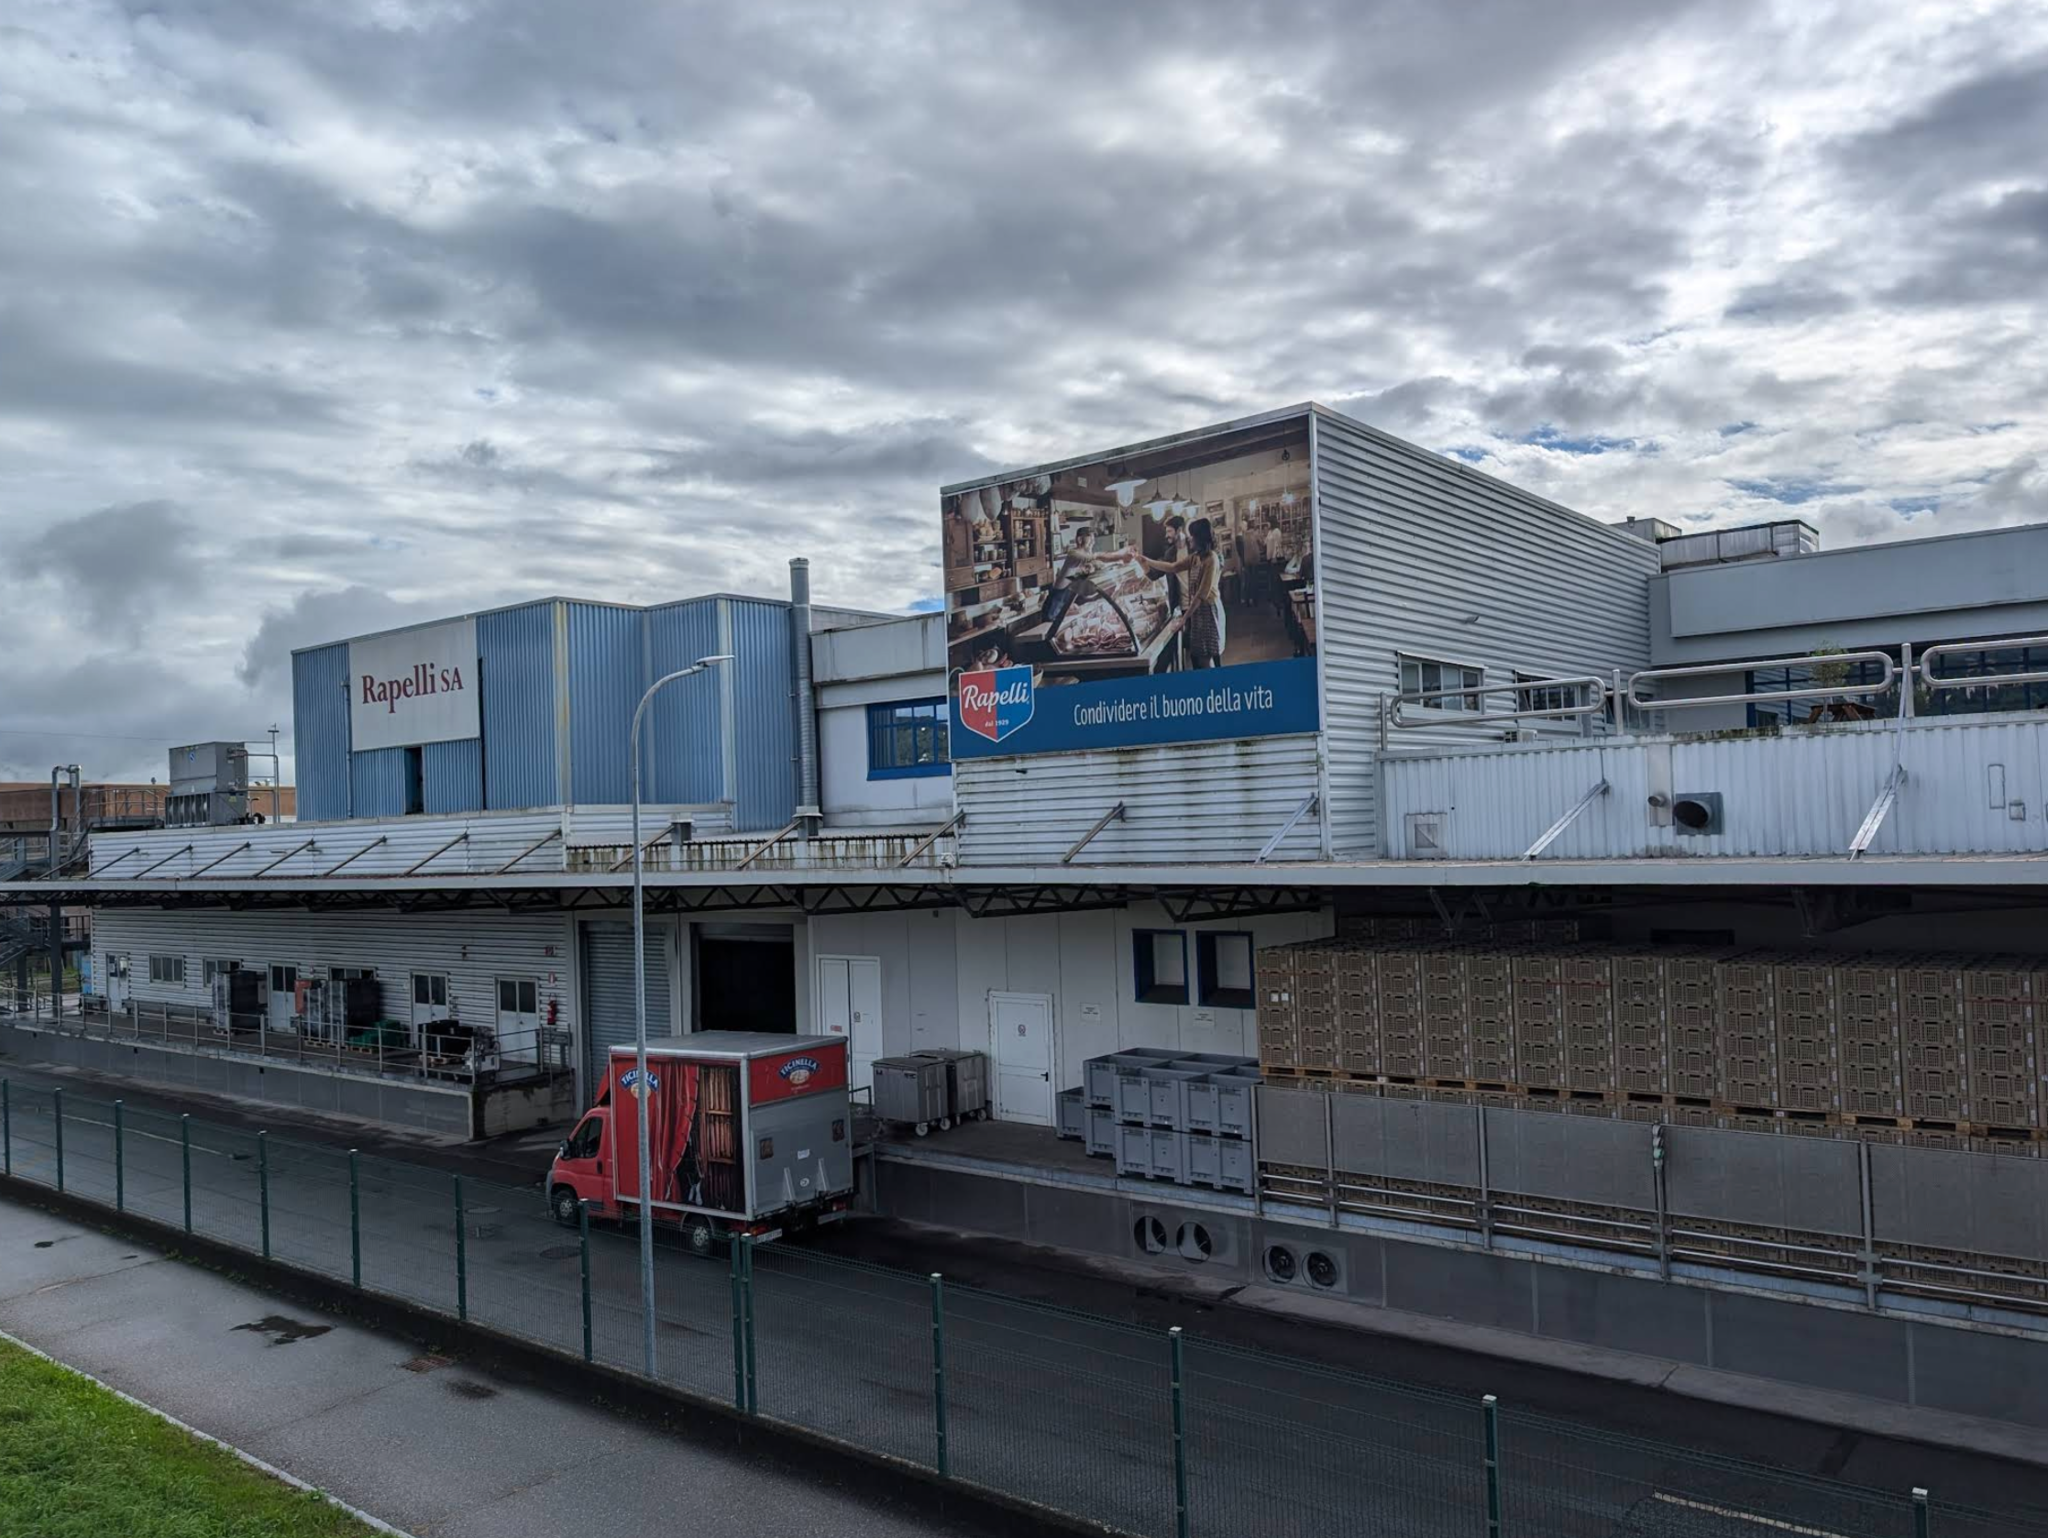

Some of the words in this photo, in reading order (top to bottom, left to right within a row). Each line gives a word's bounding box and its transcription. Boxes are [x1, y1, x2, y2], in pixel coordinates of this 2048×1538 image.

[361, 662, 437, 714] Rapelli
[440, 667, 464, 693] SA
[962, 681, 1030, 713] Rapelli
[1073, 698, 1148, 726] Condividere
[1150, 695, 1160, 720] il
[1162, 694, 1203, 718] buono
[1206, 687, 1241, 714] della
[1244, 685, 1273, 710] vita
[780, 1058, 818, 1076] TICINELLA
